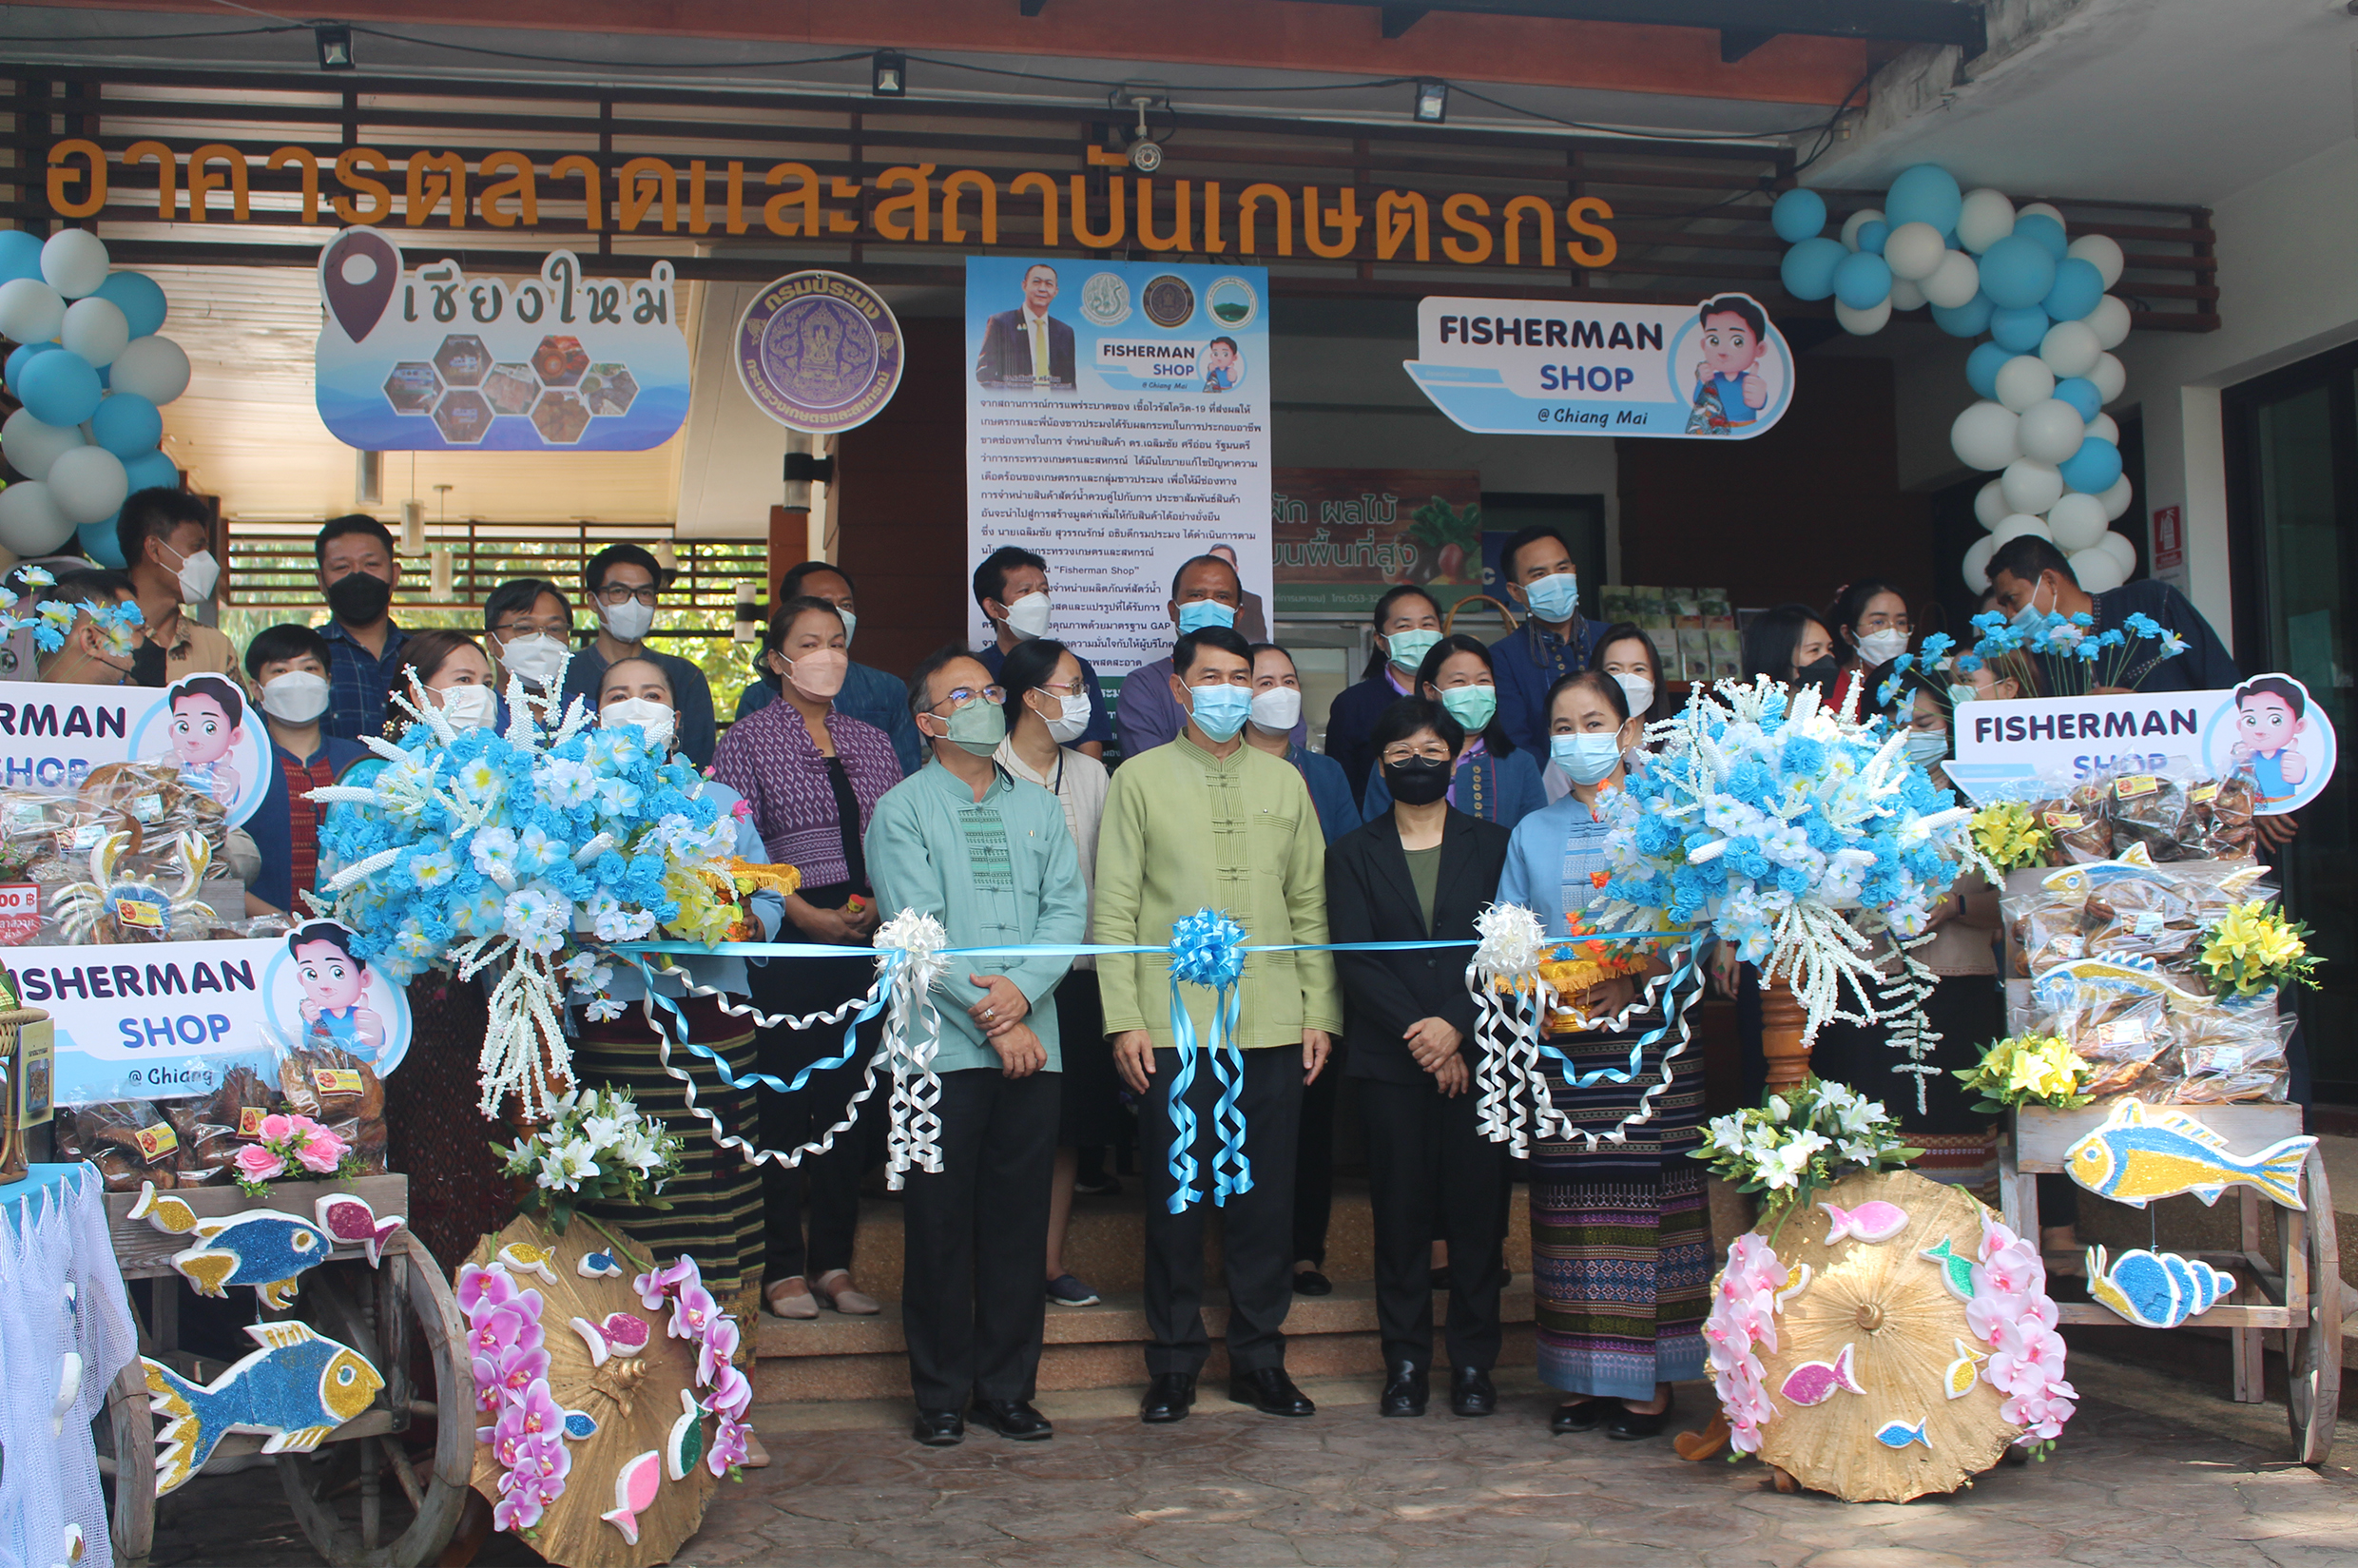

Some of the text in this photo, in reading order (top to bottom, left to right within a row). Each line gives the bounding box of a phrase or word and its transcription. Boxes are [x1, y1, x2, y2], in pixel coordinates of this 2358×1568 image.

[46, 137, 1618, 269] อาคารตลาดและสถาบันเกษตรกร
[403, 255, 667, 325] เชียงใหม่
[764, 276, 881, 319] กรมประมง
[1440, 315, 1664, 351] FISHERMAN
[1103, 344, 1195, 359] FISHERMAN
[1152, 363, 1195, 377] SHOP
[1540, 364, 1634, 392] SHOP
[1149, 381, 1172, 391] Chiang
[1537, 407, 1649, 429] @ Chiang Mai
[1321, 494, 1399, 524] ผลไม้
[1150, 622, 1171, 630] GAP
[1975, 707, 2198, 744] FISHERMAN
[0, 756, 91, 787] HOP
[119, 1014, 232, 1049] SHOP
[147, 1066, 214, 1087] Chiang
